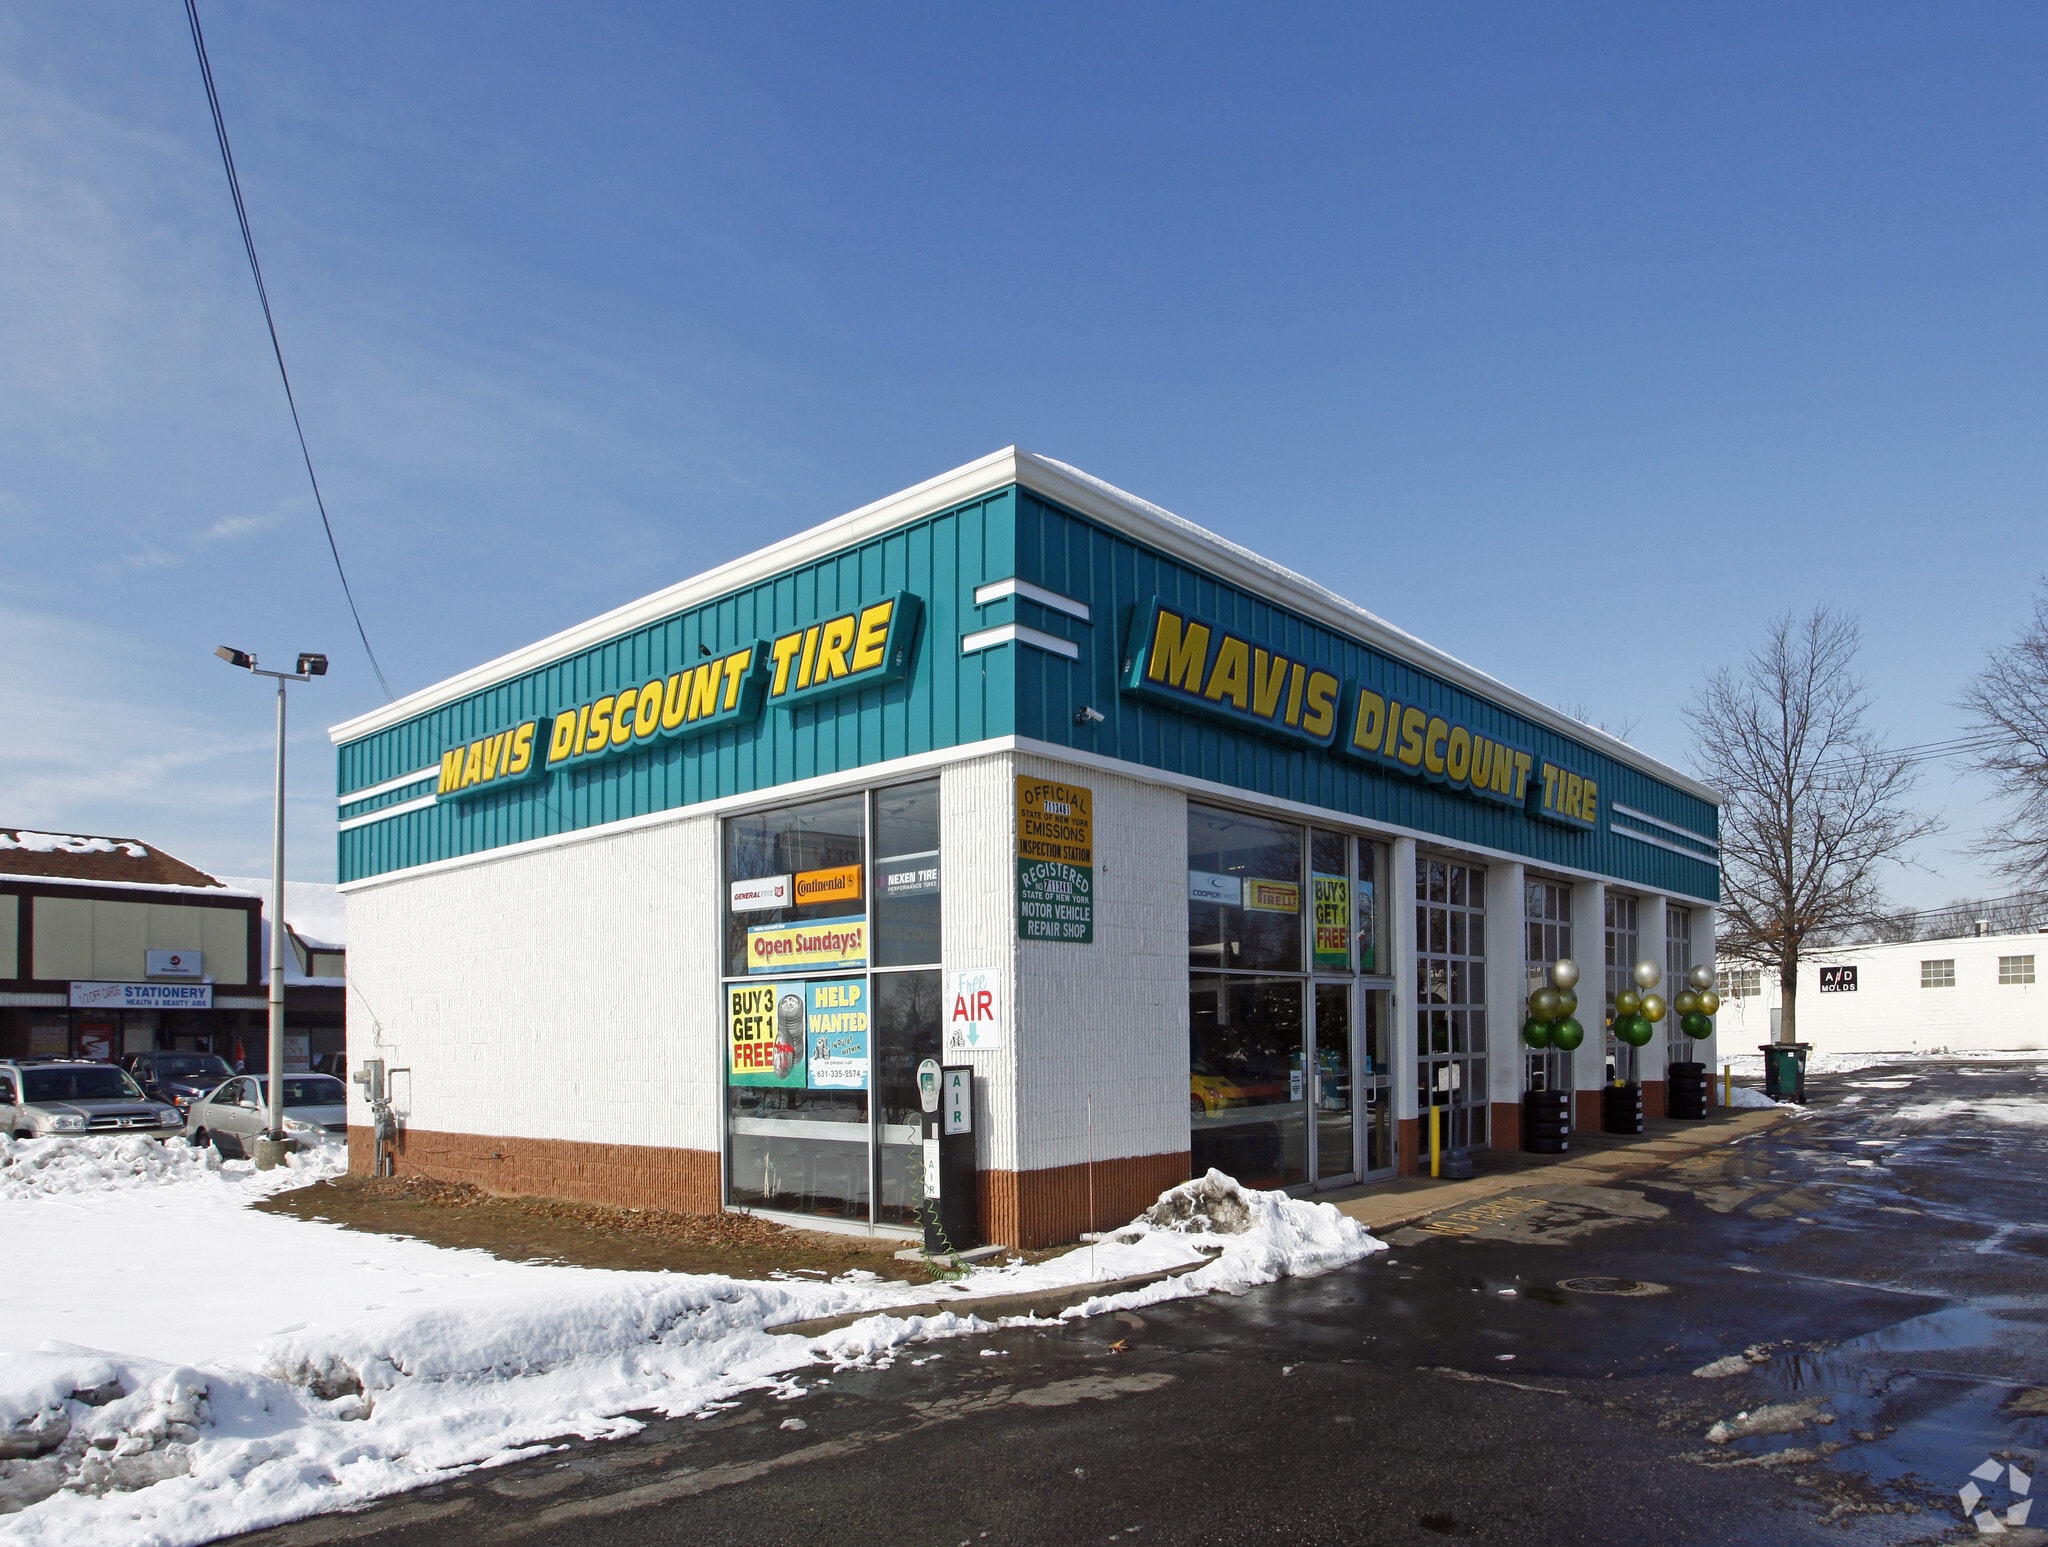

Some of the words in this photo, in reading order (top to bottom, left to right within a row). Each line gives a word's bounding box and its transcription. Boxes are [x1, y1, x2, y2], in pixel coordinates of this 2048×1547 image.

[437, 721, 536, 795] MAVIS
[548, 648, 752, 763] DISCOUNT
[771, 599, 895, 697] TIRE
[1147, 609, 1339, 738] MAVIS
[1353, 688, 1532, 802] DISCOUNT
[1542, 762, 1598, 823] TIRE
[1025, 785, 1086, 814] OFFICIAL
[1021, 809, 1042, 819] STATE
[1055, 815, 1070, 824] NEW
[1072, 817, 1088, 827] YORK
[1025, 819, 1085, 843] EMISSIONS
[1020, 839, 1062, 859] INSPECTION
[1063, 845, 1091, 862] STATION
[798, 875, 846, 897] Continental
[888, 872, 916, 885] NEXEN
[918, 868, 937, 881] TIRE
[888, 882, 922, 892] PERFORMANCE
[1021, 862, 1089, 893] REGISTERED
[1022, 890, 1043, 899] STATE
[1045, 892, 1054, 900] OF
[1056, 894, 1070, 902] NEW
[1072, 895, 1089, 904] YORK
[1192, 889, 1220, 898] COOPER
[1257, 885, 1297, 906] PIRELLI
[1315, 880, 1337, 901] BUY
[1339, 882, 1346, 902] 3
[1021, 901, 1052, 918] MOTOR
[1055, 904, 1091, 921] VEHICLE
[1315, 903, 1338, 925] GET
[1341, 904, 1346, 925] 1
[1028, 920, 1060, 937] REPAIR
[1063, 923, 1086, 938] SHOP
[1316, 926, 1346, 949] FREE
[754, 937, 792, 962] Open
[796, 927, 862, 956] Sundays!
[125, 986, 206, 998] STATIONERY
[958, 973, 987, 996] Free
[1821, 983, 1856, 992] MOLDS
[732, 990, 762, 1015] BUY
[764, 988, 774, 1013] 3
[815, 985, 861, 1008] HELP
[952, 990, 994, 1022] AIR
[733, 1016, 763, 1042] GET
[766, 1015, 773, 1039] 1
[809, 1012, 868, 1034] WANTED
[734, 1042, 774, 1069] FREE
[817, 1069, 860, 1078] 631-335-2574
[953, 1075, 962, 1123] AIR
